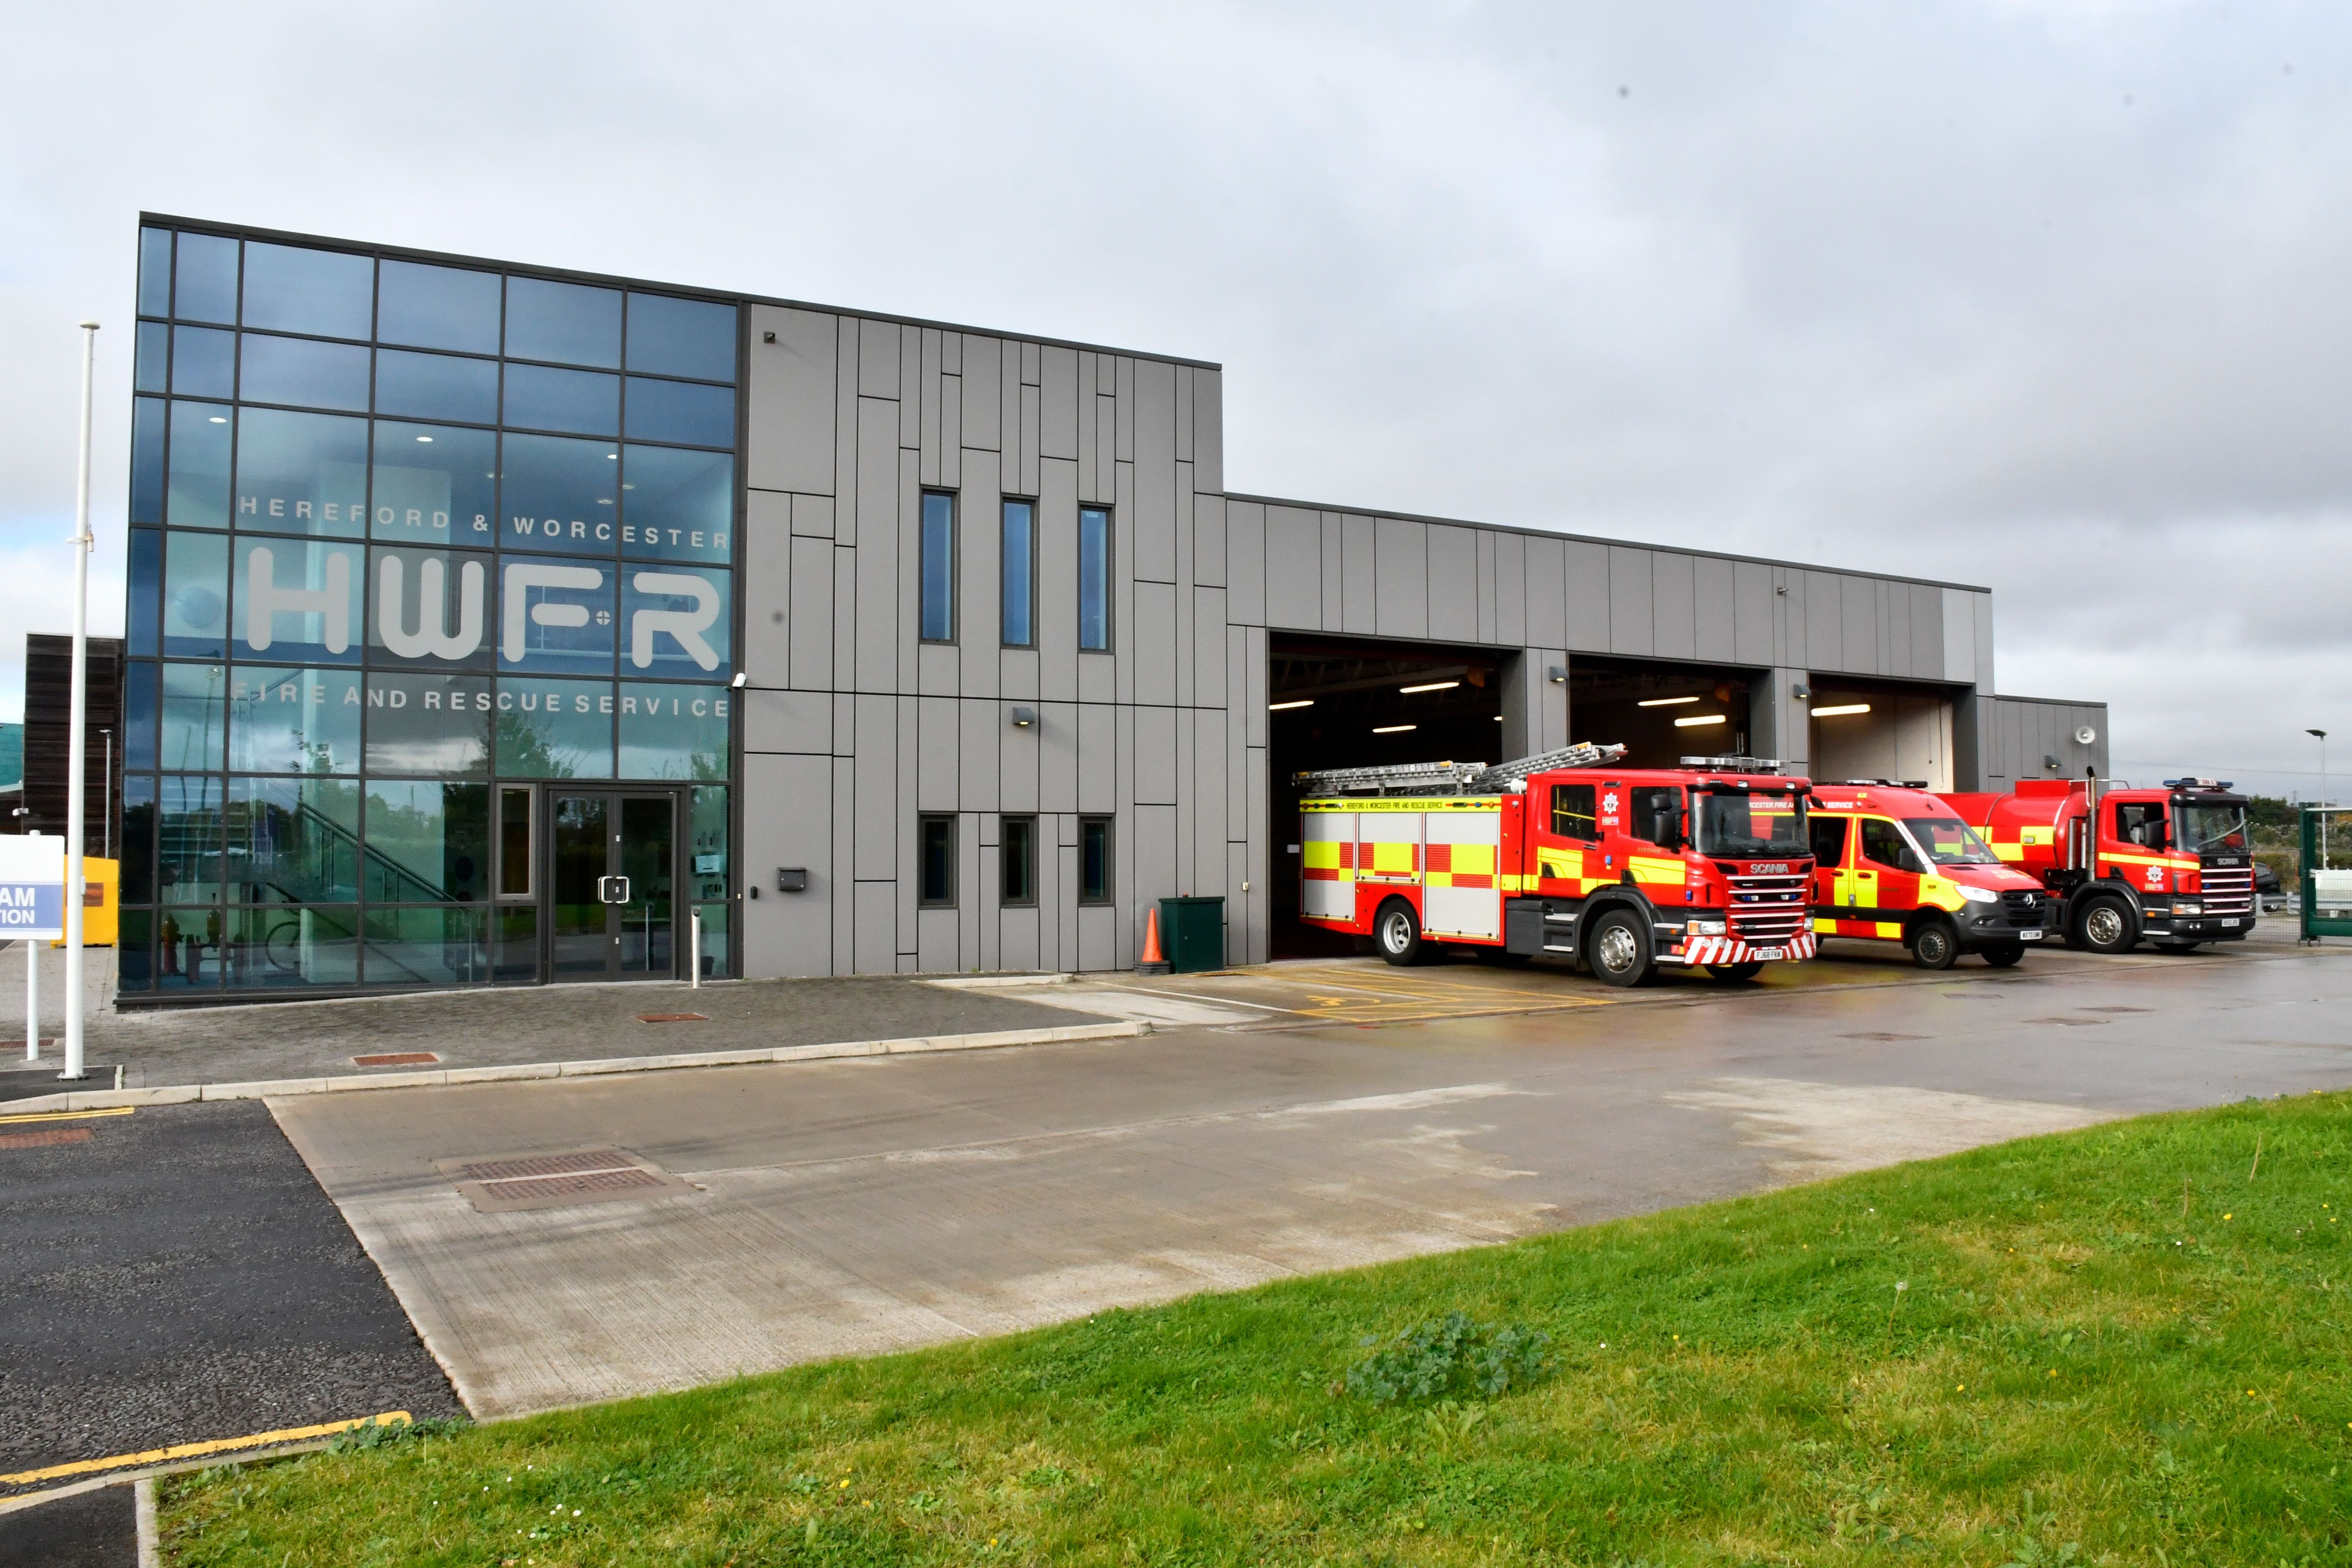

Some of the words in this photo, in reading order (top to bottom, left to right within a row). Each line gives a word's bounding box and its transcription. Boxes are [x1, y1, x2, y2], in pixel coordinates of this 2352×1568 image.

[239, 496, 449, 528] HEREFORD
[473, 514, 488, 531] &
[514, 516, 727, 550] WORCESTER
[231, 682, 326, 704] FIRE
[343, 686, 407, 708] AND
[425, 690, 561, 712] RESCUE
[575, 694, 728, 717] SERVICE
[1750, 863, 1789, 874] SCANIA
